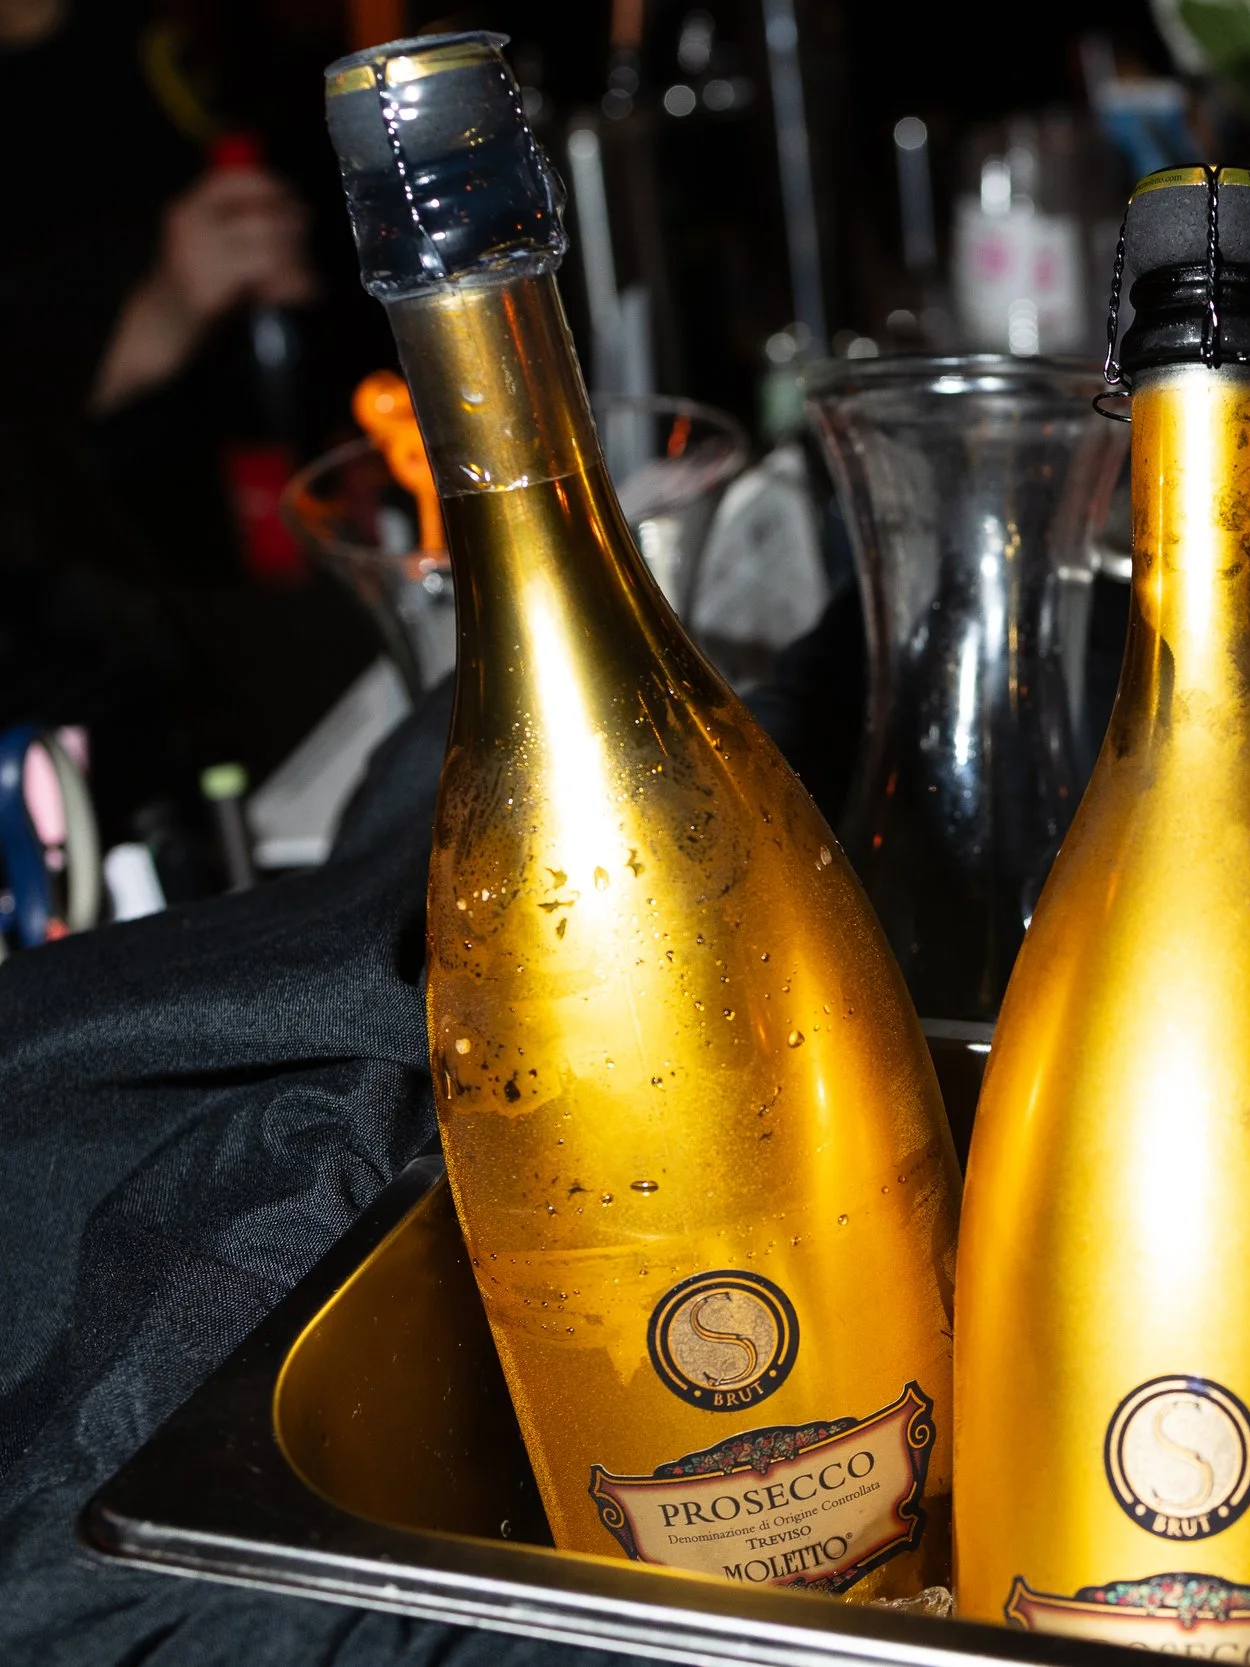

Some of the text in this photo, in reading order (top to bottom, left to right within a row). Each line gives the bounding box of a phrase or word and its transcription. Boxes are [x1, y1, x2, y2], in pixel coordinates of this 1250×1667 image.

[713, 1380, 765, 1407] BRUT
[658, 1451, 875, 1528] PROSECCO
[668, 1481, 881, 1545] Denominazione di Origine Controllata
[1152, 1513, 1210, 1537] BRUT
